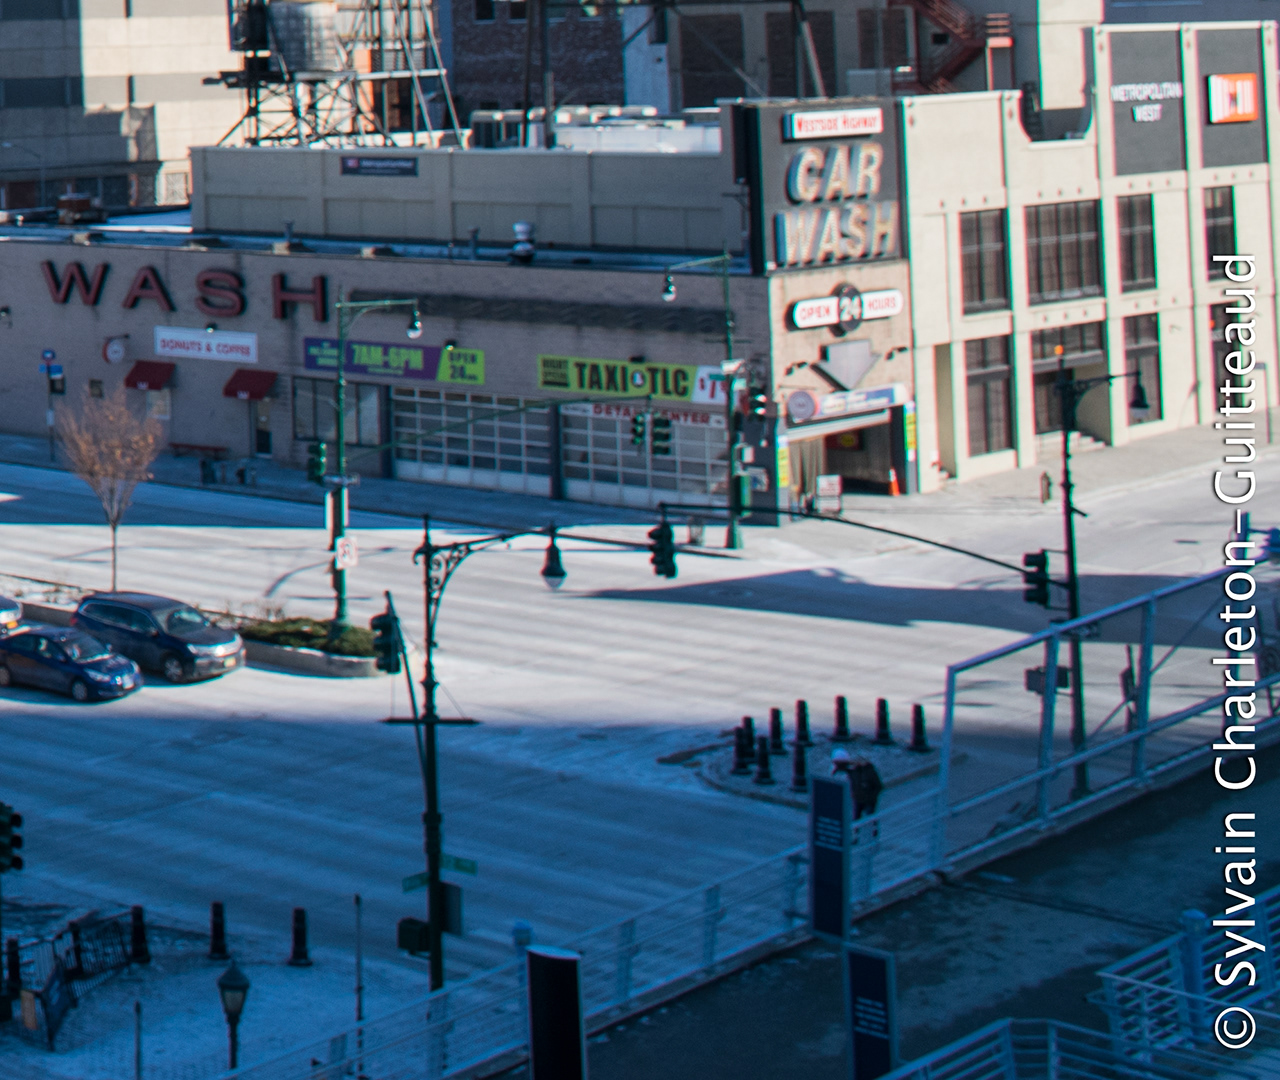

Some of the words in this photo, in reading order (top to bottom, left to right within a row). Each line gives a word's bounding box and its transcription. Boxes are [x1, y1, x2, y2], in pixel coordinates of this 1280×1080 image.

[1111, 82, 1183, 102] METROPOLITAN
[1132, 104, 1163, 122] WEST
[788, 142, 884, 204] CAR
[777, 200, 900, 266] WASH
[40, 259, 331, 323] WASH
[799, 305, 831, 321] OPEN
[839, 295, 863, 322] 24
[868, 296, 897, 311] HOURS
[160, 338, 202, 352] DONUTS
[205, 341, 213, 353] &
[215, 343, 252, 356] COFFEE
[574, 361, 629, 393] TAXI
[644, 366, 689, 397] TLC
